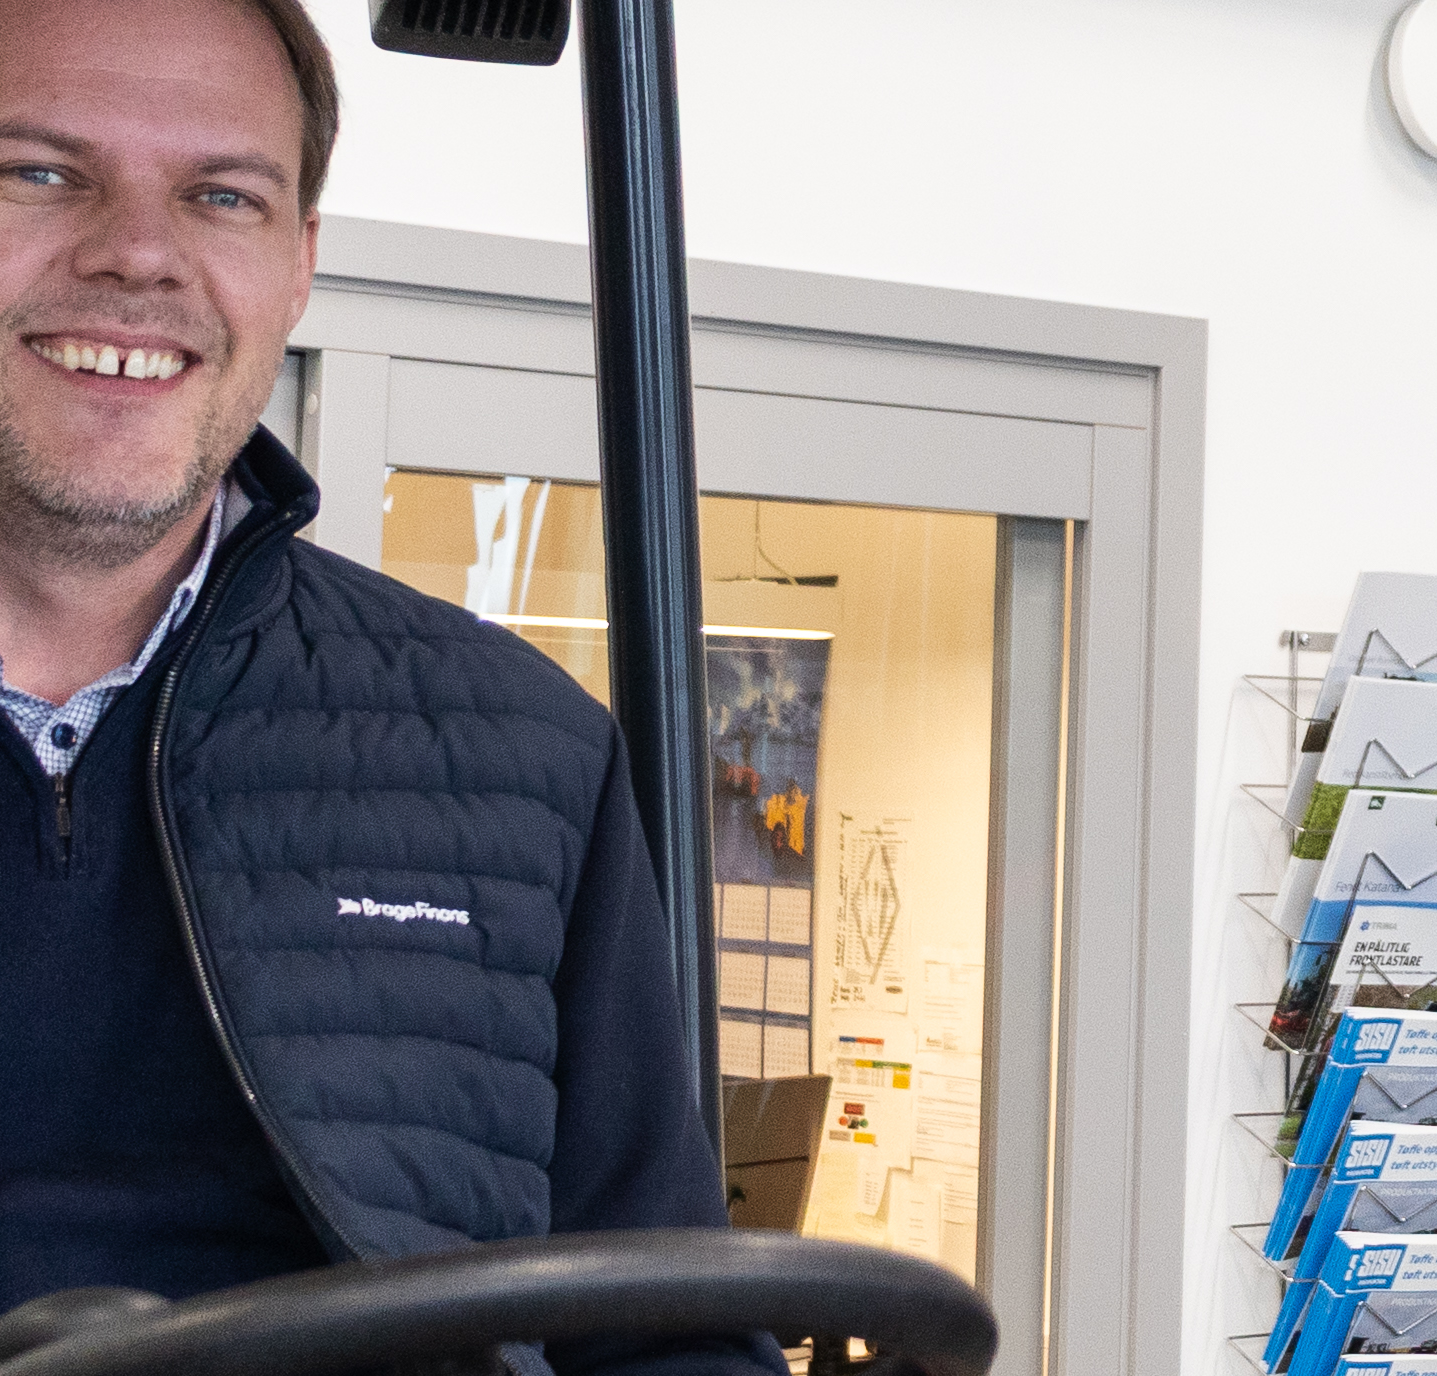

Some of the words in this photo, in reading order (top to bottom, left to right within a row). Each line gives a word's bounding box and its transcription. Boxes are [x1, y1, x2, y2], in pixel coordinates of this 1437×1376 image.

[1362, 880, 1402, 894] Katana
[361, 897, 471, 925] BrageFinans
[1354, 941, 1368, 953] EN
[1367, 939, 1412, 953] PÅLITLIG
[1348, 954, 1423, 967] FRONTLASTARE
[1355, 1023, 1399, 1051] SISU
[1404, 1028, 1430, 1041] Tøffe
[1398, 1044, 1420, 1056] tøft
[1345, 1137, 1390, 1168] SISU
[1397, 1143, 1423, 1155] Tøffe
[1390, 1158, 1412, 1170] tøft
[1356, 1248, 1402, 1276] SISU
[1409, 1254, 1436, 1266] Tøffe
[1401, 1269, 1424, 1281] tøft
